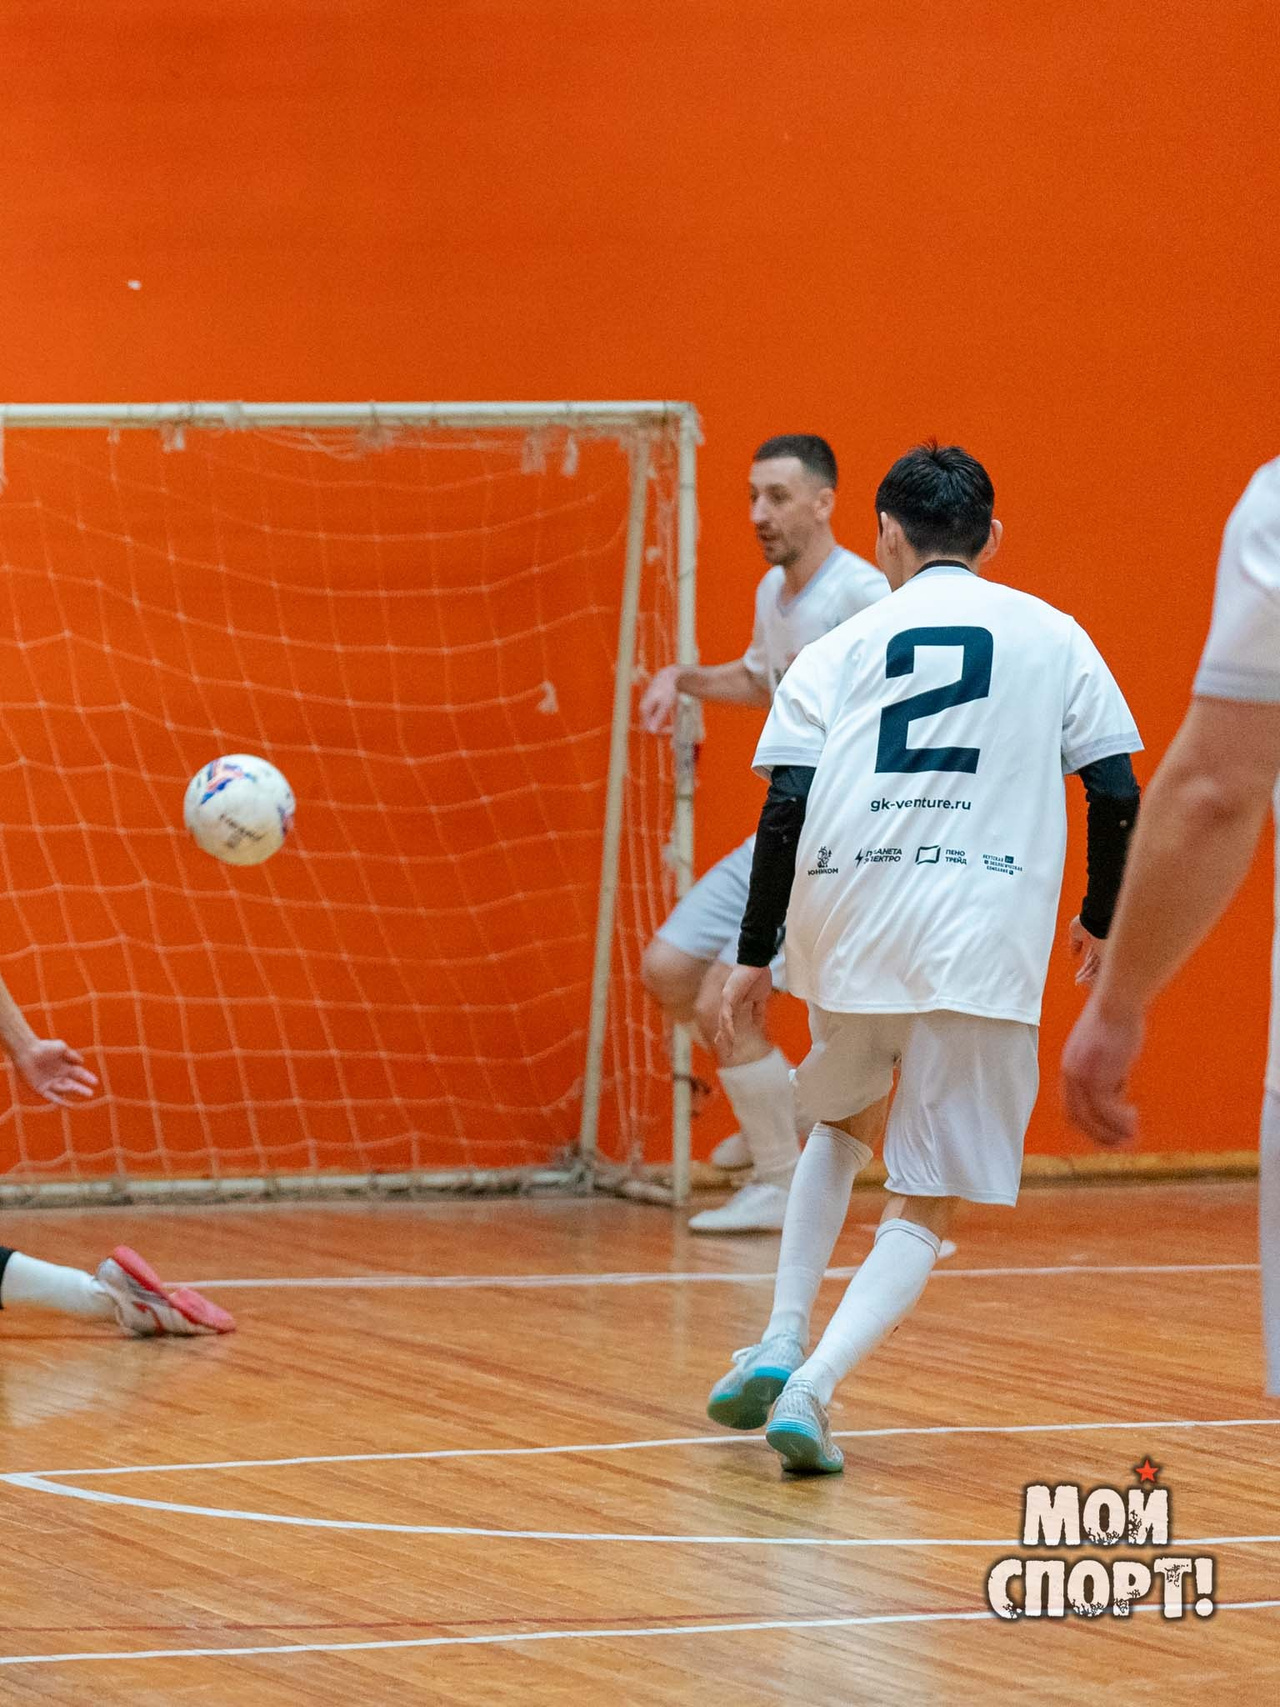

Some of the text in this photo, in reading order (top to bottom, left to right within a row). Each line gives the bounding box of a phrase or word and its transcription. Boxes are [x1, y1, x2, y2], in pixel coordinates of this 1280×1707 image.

[874, 626, 994, 774] 2
[870, 797, 972, 813] gk-venture.ru
[945, 848, 966, 857] ПЕНО
[945, 856, 968, 866] ТРЕЙД
